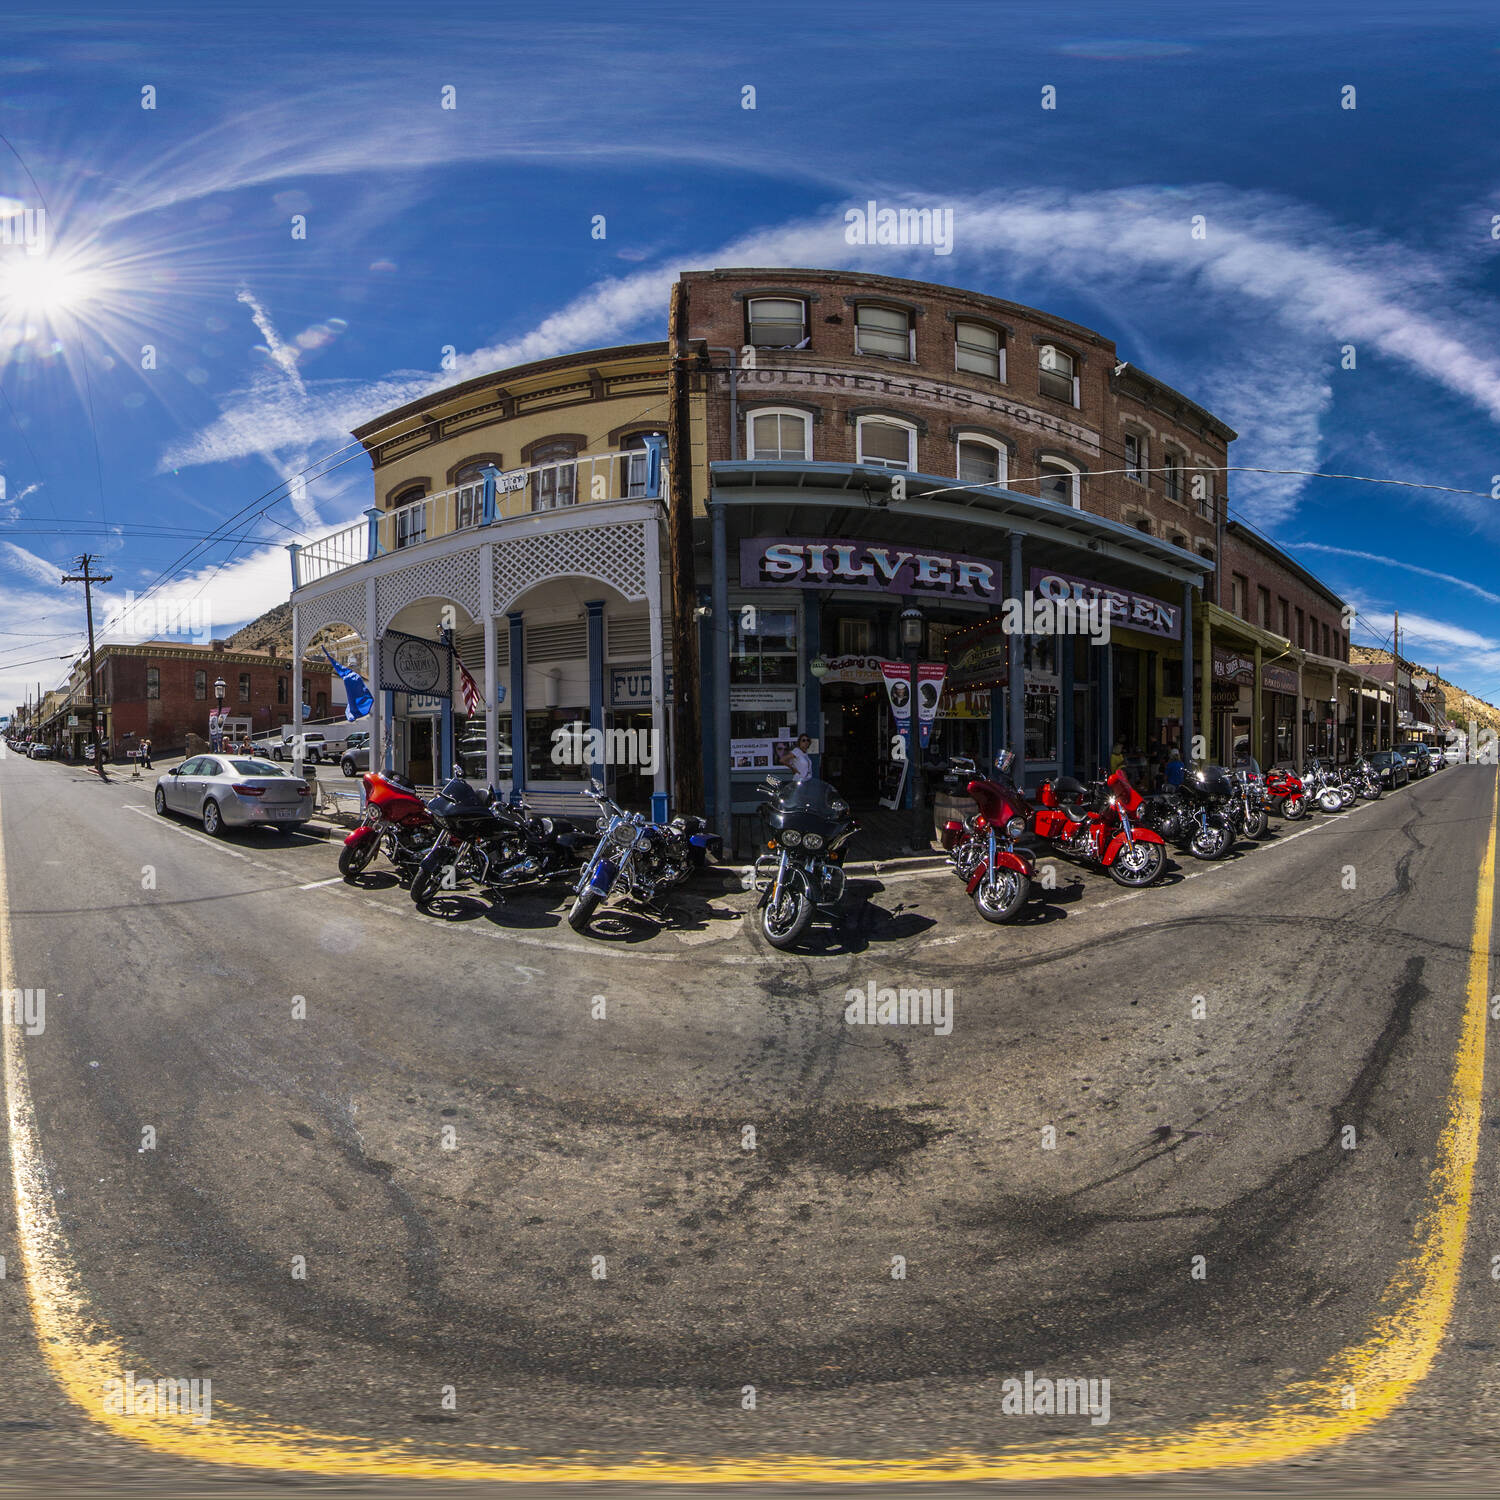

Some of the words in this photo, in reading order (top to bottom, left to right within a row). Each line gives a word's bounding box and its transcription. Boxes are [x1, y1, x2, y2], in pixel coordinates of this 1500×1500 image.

[764, 544, 995, 591] SILVER
[1039, 575, 1176, 629] QUEEN
[1264, 677, 1281, 688] BAKED
